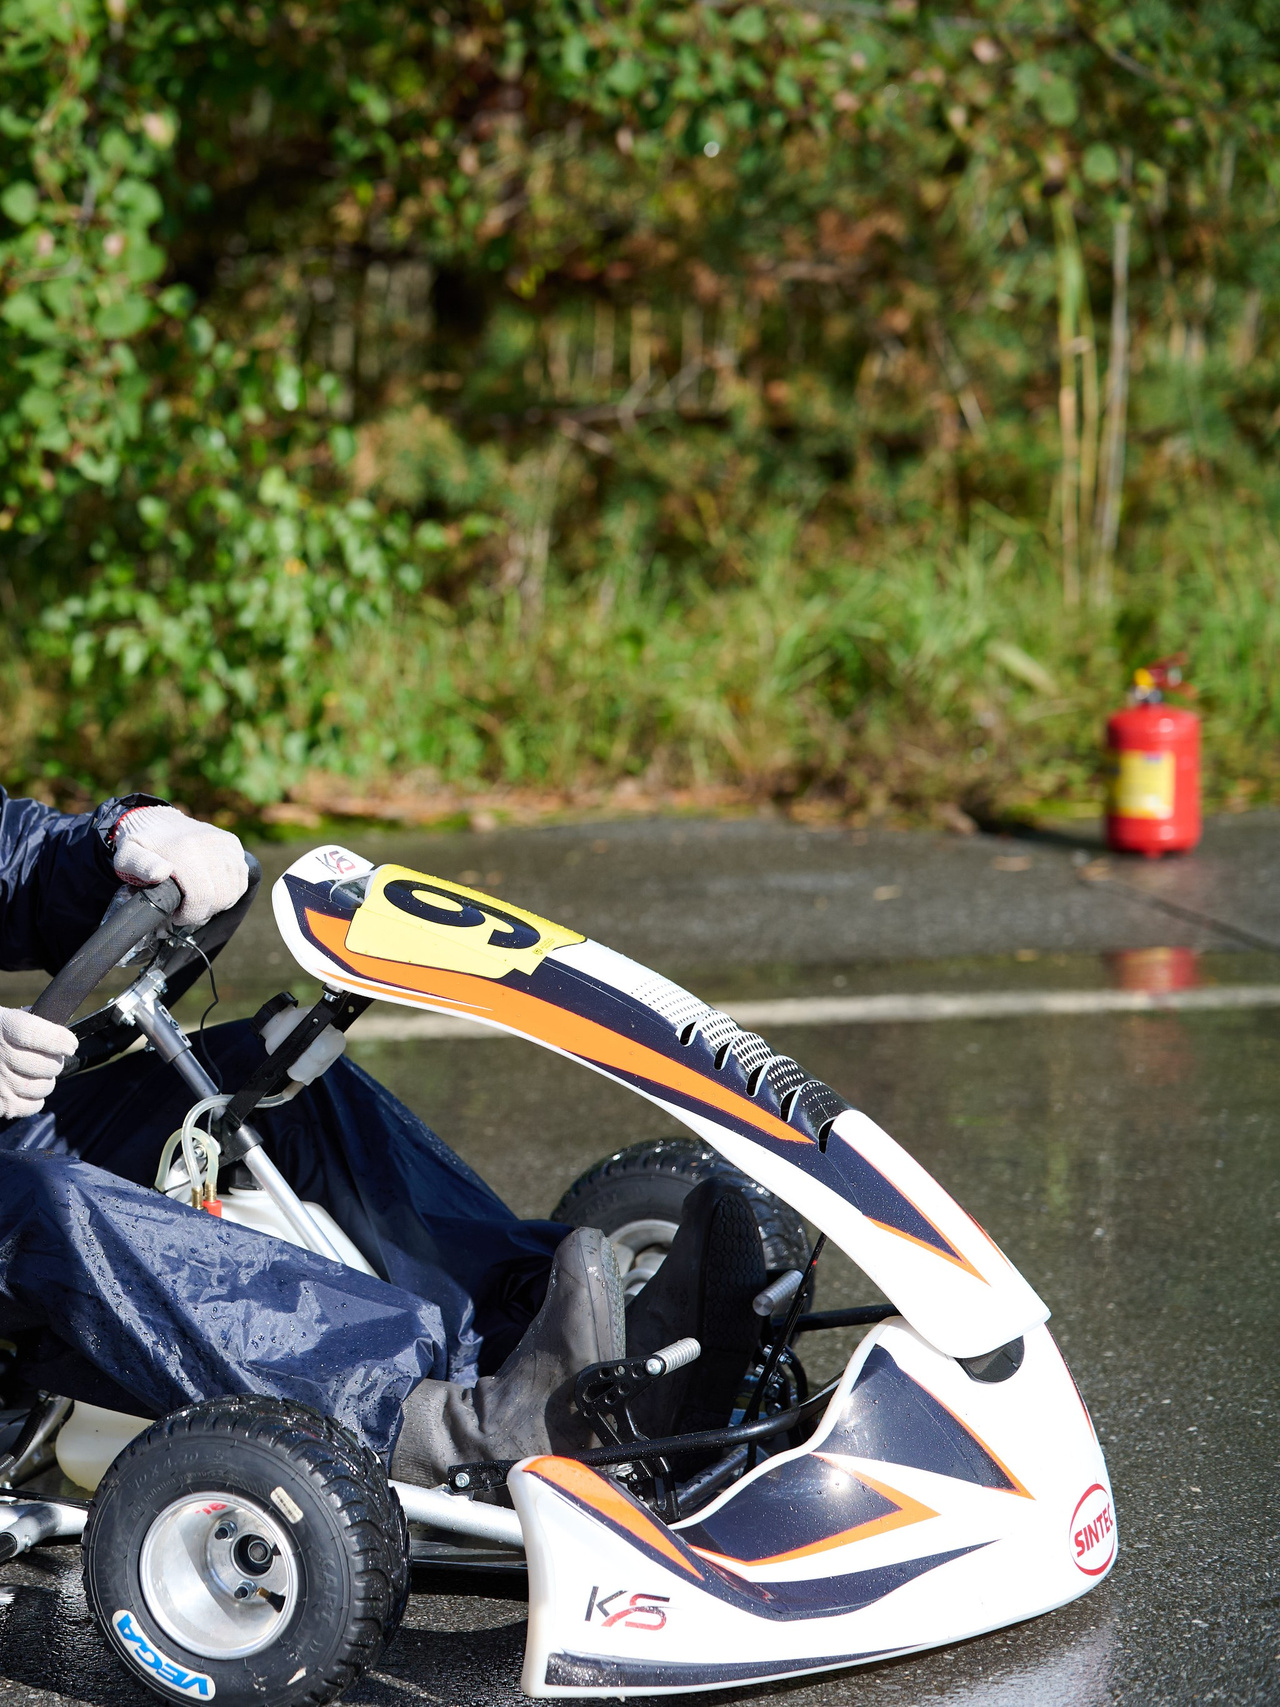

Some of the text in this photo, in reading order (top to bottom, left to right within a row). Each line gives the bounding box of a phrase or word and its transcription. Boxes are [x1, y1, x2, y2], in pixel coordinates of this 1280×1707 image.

[383, 879, 541, 950] 9
[1074, 1502, 1114, 1558] SINTEC
[116, 1613, 209, 1696] VEGA
